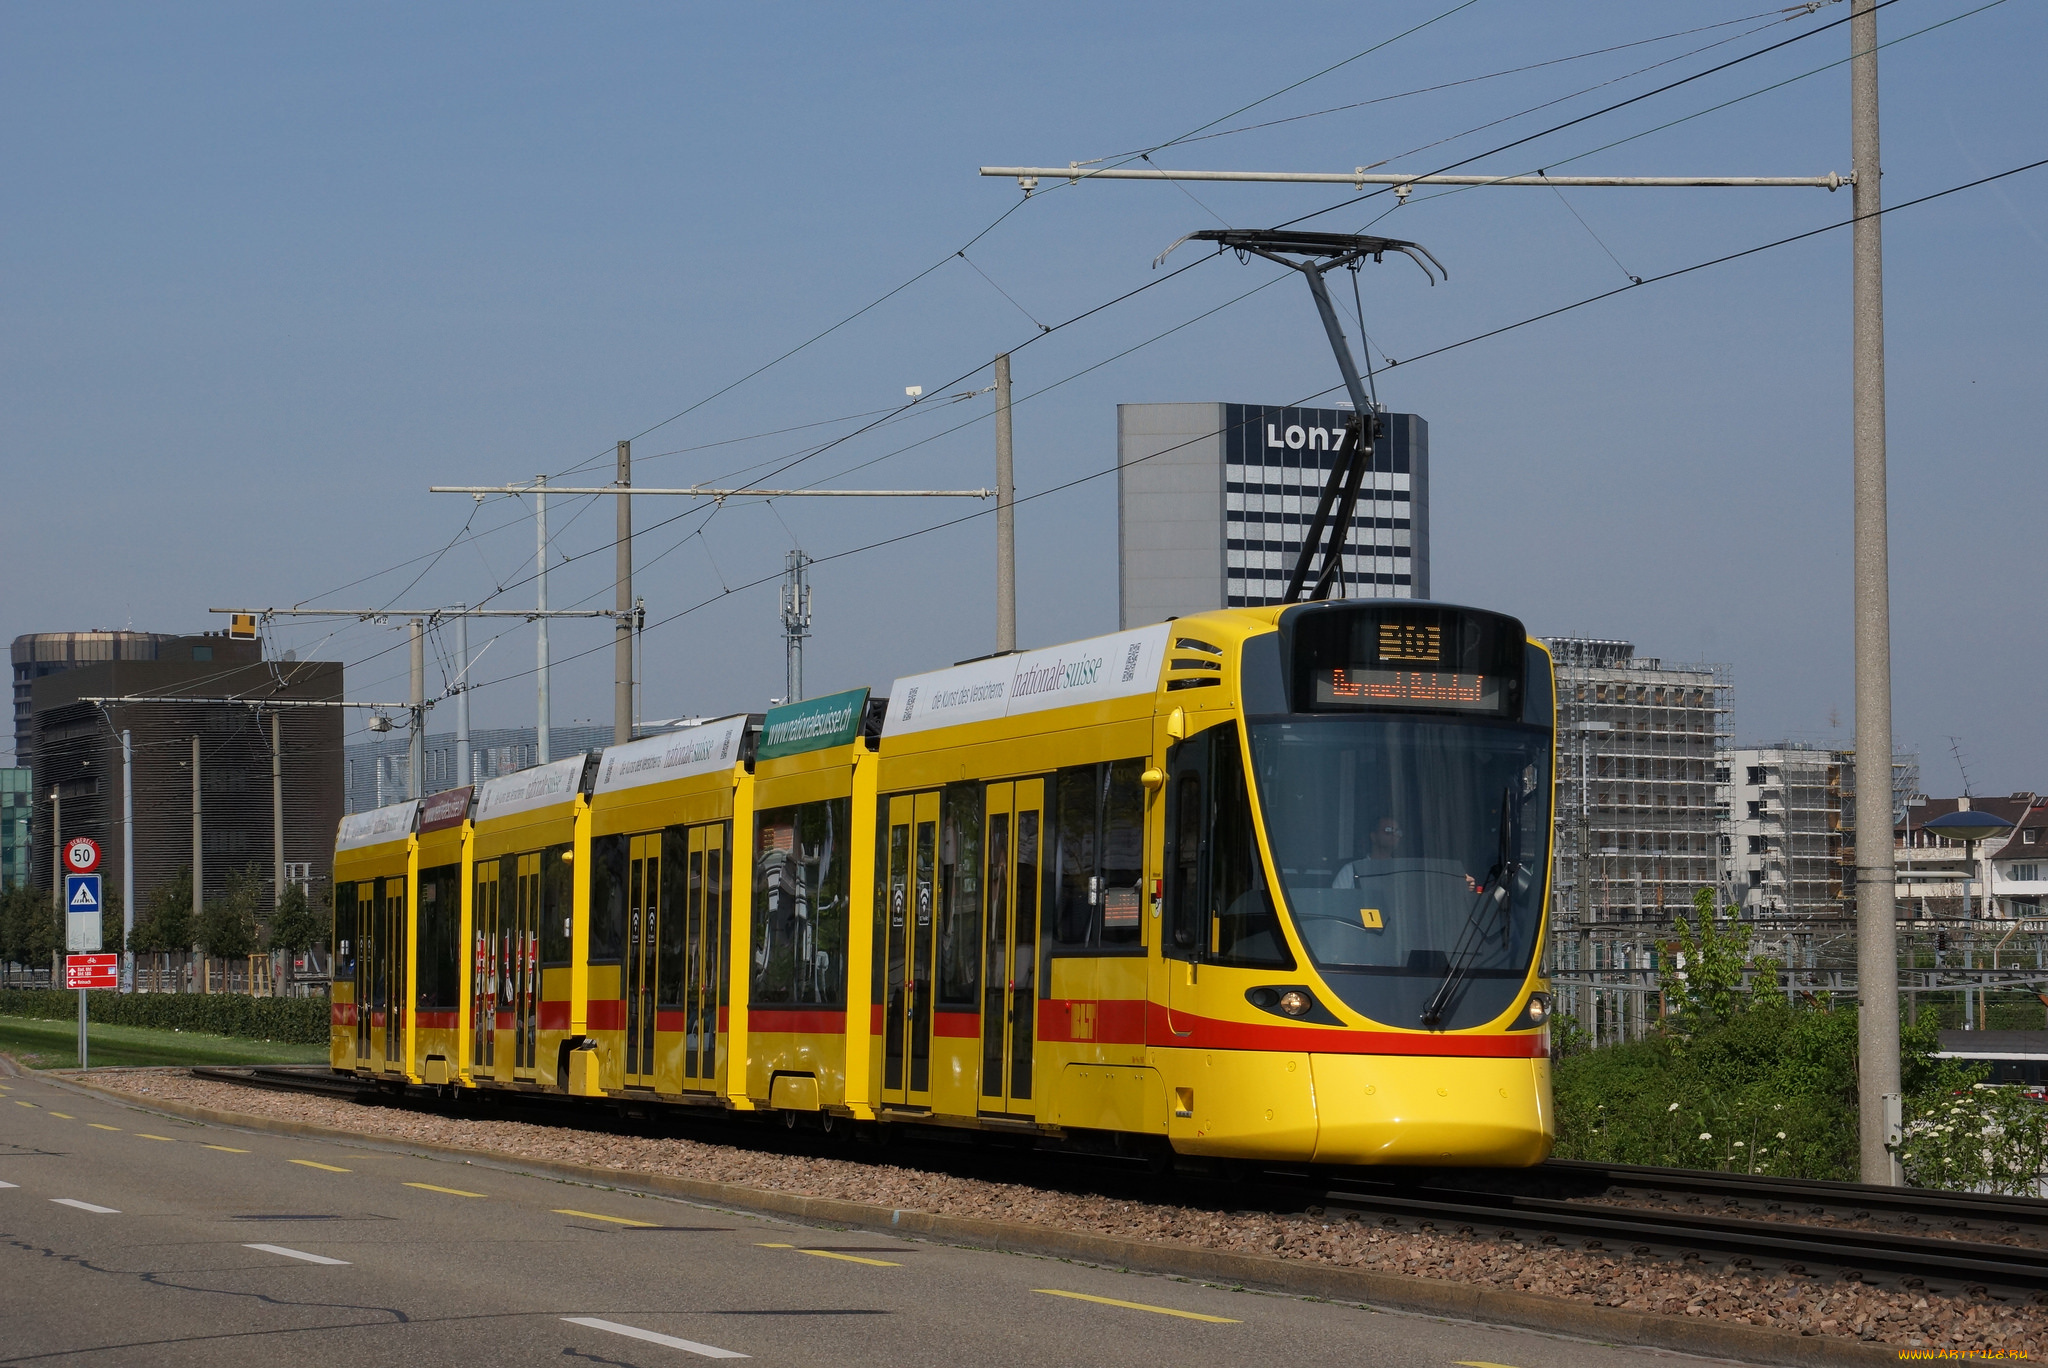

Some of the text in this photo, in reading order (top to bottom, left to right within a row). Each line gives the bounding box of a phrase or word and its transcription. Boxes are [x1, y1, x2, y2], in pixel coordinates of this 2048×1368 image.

[1267, 423, 1359, 451] Lonz
[941, 688, 959, 709] Kunst
[1012, 652, 1103, 698] nationalesuisse
[767, 702, 853, 746] www.nationalesuisse.ch
[74, 849, 90, 862] 50
[1368, 911, 1375, 922] 1
[1071, 1003, 1097, 1039] BLT
